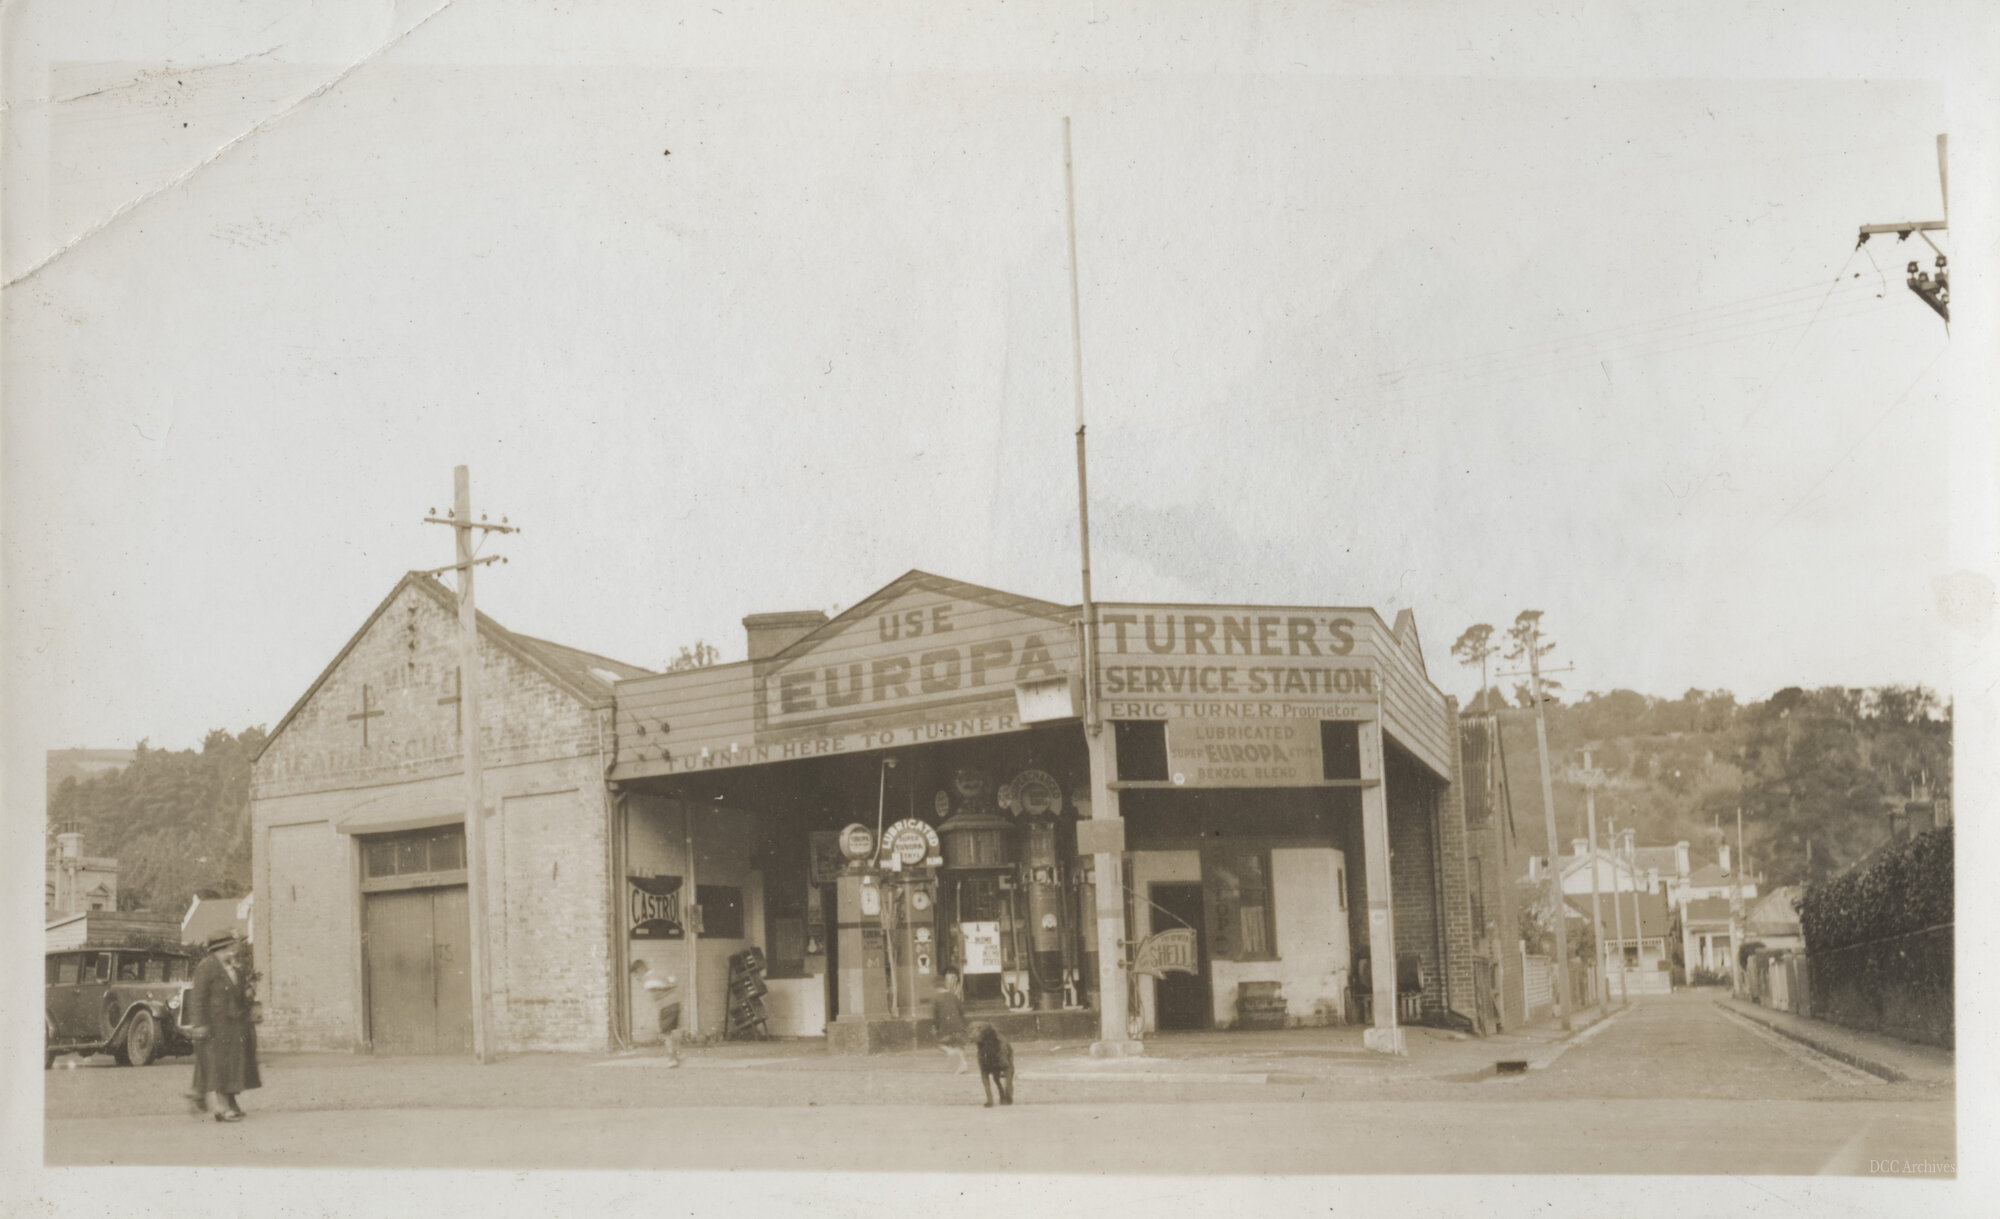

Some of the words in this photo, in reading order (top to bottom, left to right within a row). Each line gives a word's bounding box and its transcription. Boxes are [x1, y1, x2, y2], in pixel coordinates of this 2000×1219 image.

[878, 604, 954, 643] USE
[1102, 613, 1356, 657] TURNER'S
[780, 634, 1066, 714] EUROPA
[1105, 665, 1239, 695] SERVICE
[1247, 667, 1373, 696] STATION
[1110, 702, 1167, 718] ERIC
[668, 748, 732, 773] TURN
[746, 746, 769, 764] IN
[783, 738, 846, 758] HERE
[862, 730, 895, 747] TO
[908, 714, 1015, 742] TURNER
[1196, 726, 1294, 740] LUBRICATED
[1171, 747, 1204, 759] SUPER
[1204, 743, 1289, 763] EUROPA
[1197, 767, 1248, 779] BENZOL
[1255, 767, 1297, 779] BLEND
[881, 818, 939, 850] LUBRICATED
[631, 888, 683, 928] CASTROL
[1149, 944, 1190, 968] SHELL
